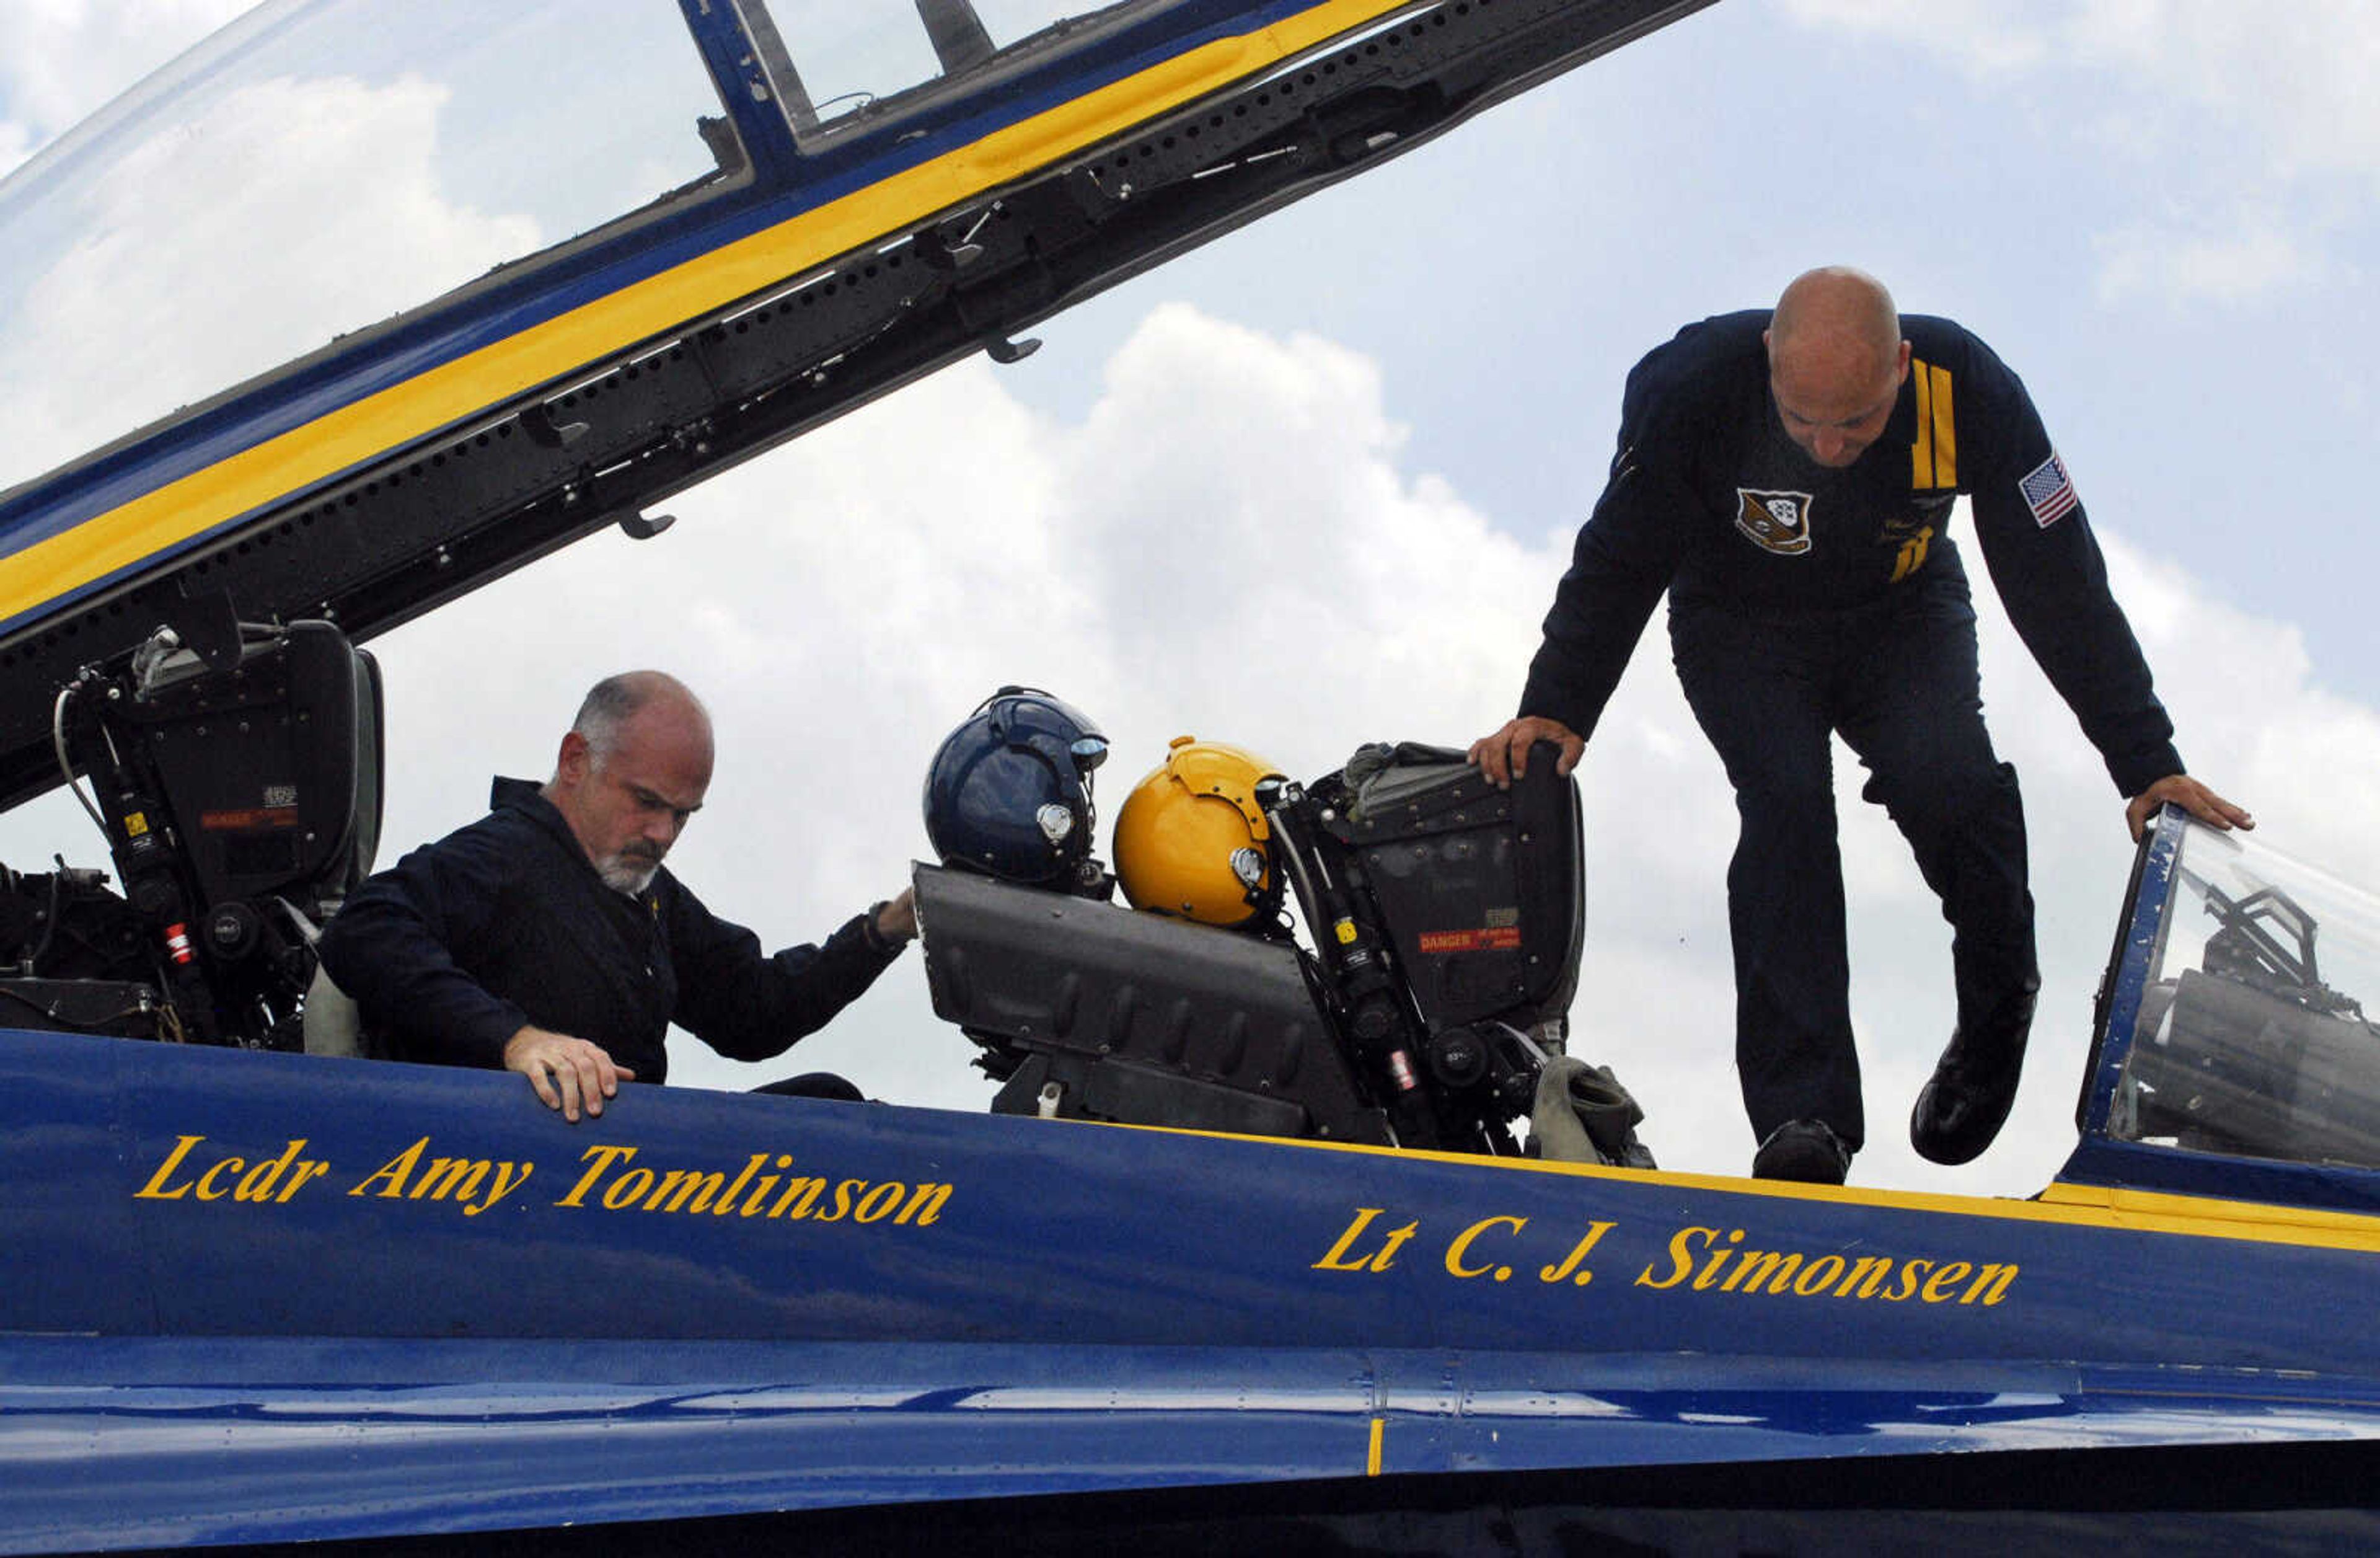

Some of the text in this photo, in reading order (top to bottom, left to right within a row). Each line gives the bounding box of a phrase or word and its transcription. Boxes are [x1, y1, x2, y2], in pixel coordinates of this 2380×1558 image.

[1420, 933, 1471, 950] DANGER
[133, 1135, 953, 1226] Lcdr Amy Tomlinson
[1311, 1207, 2019, 1306] Lt C. J. Simonsen
